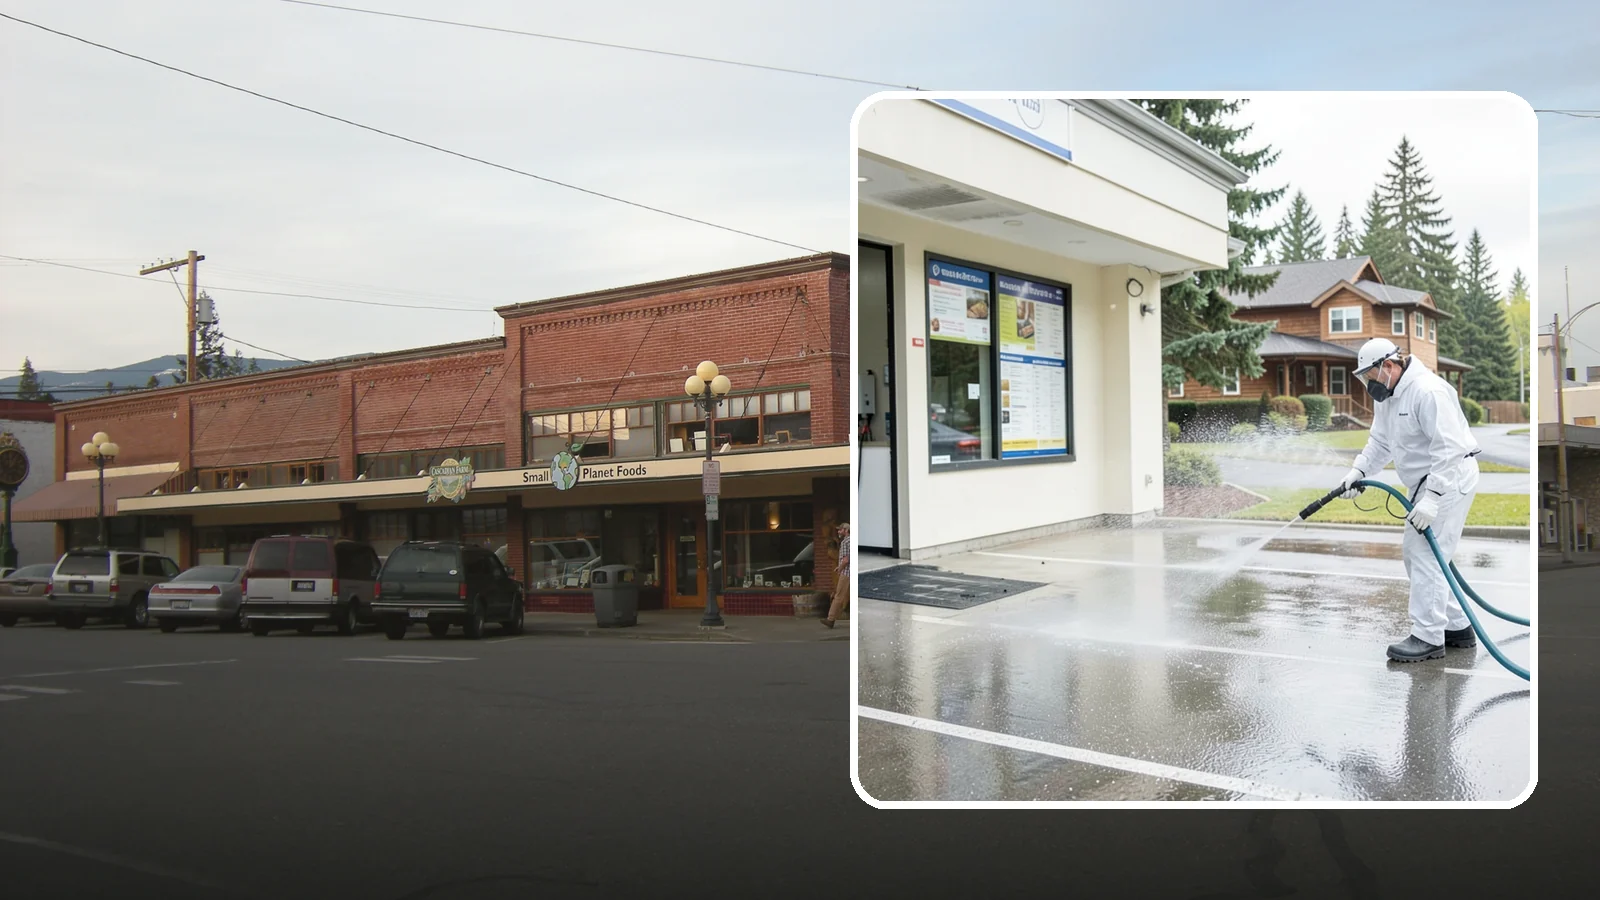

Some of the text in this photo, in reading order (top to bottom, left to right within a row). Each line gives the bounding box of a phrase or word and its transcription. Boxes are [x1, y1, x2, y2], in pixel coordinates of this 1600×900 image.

[523, 464, 647, 483] Small Planet Foods
